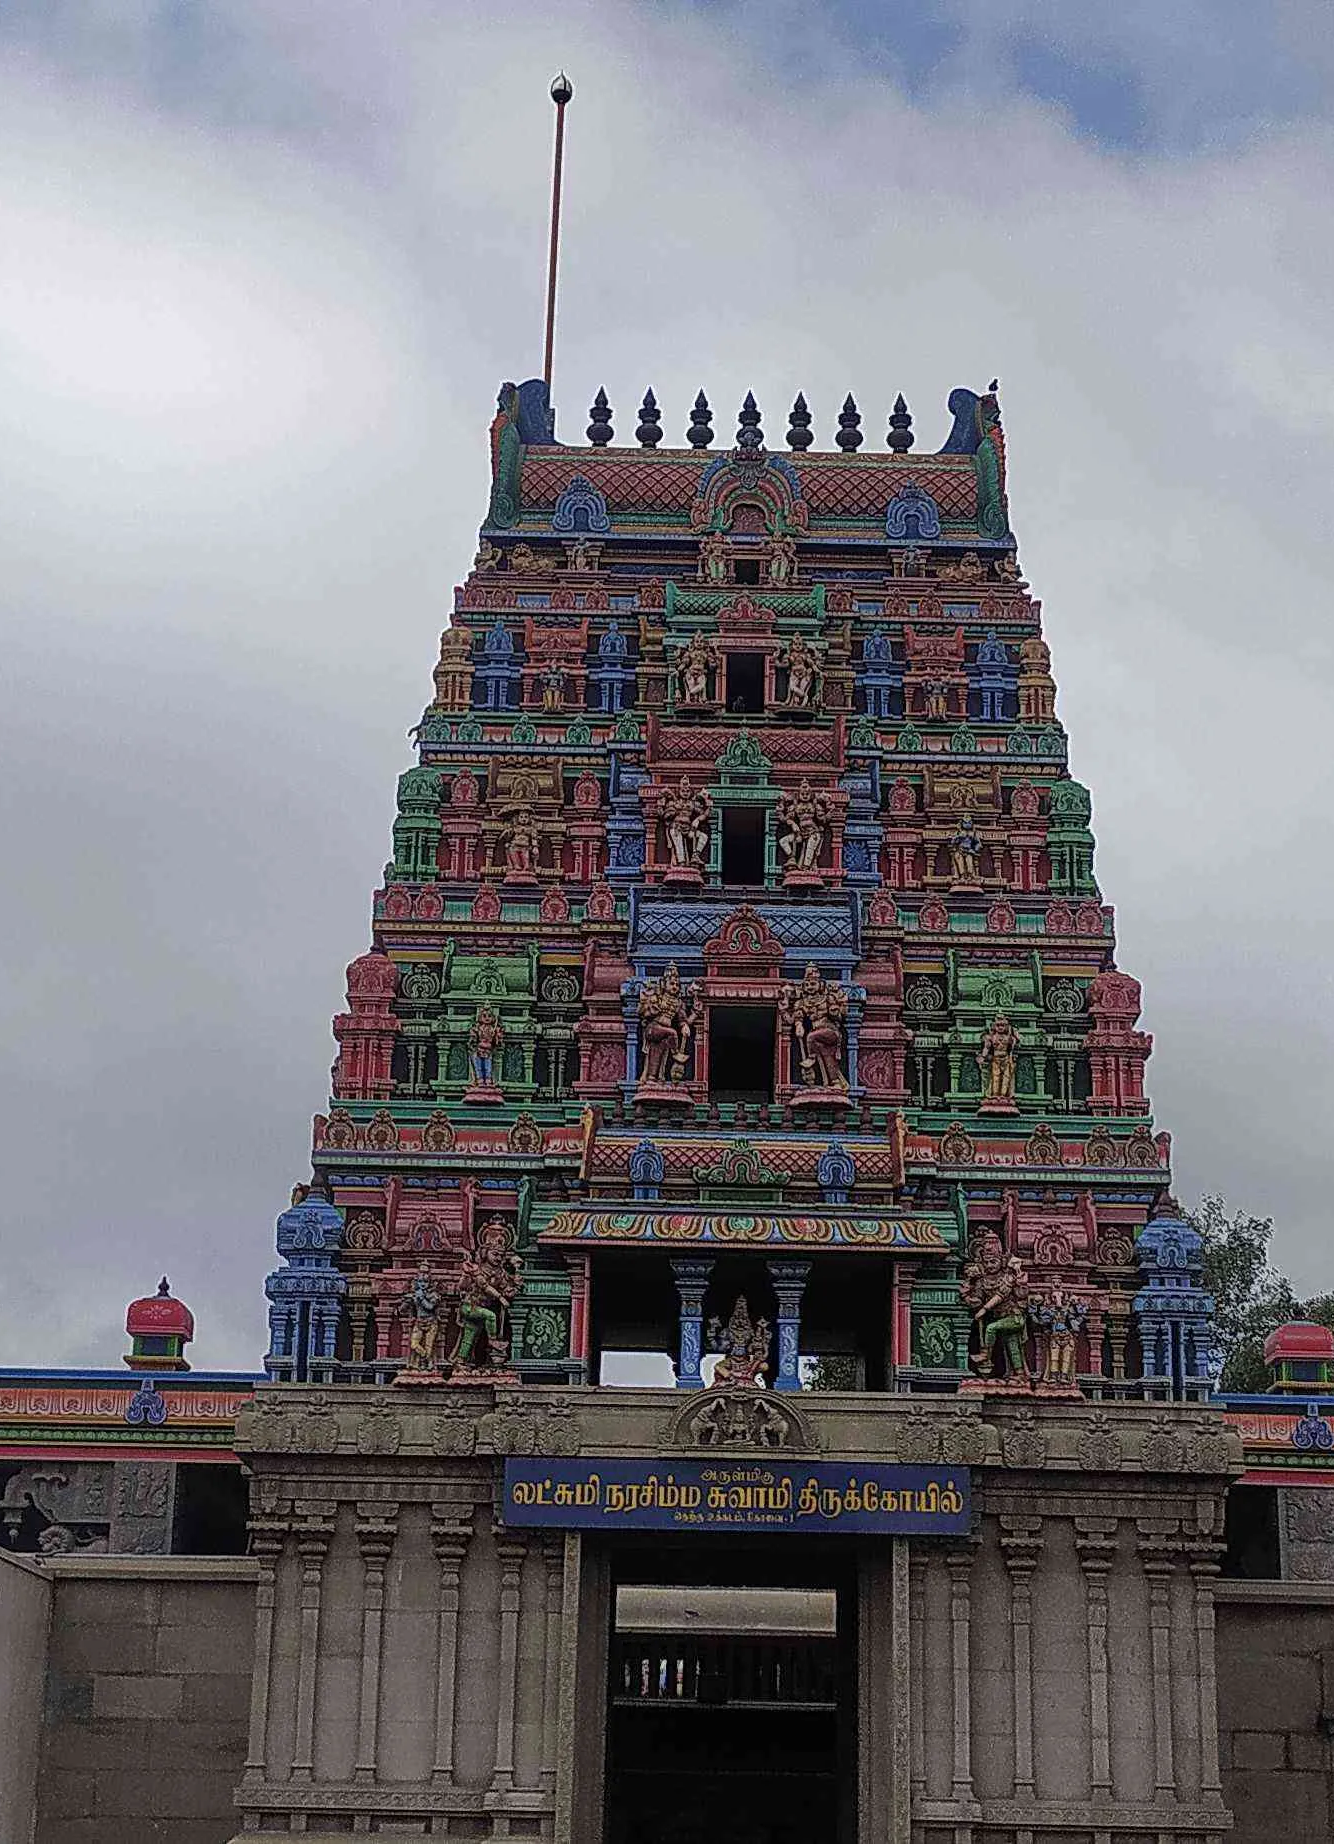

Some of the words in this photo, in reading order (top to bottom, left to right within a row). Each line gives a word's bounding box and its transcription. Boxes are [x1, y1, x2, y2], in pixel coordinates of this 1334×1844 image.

[700, 1468, 775, 1485] அருள்மிகு
[513, 1474, 600, 1505] லட்சுமி
[604, 1475, 701, 1514] நரசிம்ம
[708, 1477, 792, 1510] சுவாமி
[797, 1478, 964, 1519] திருக்கோயில்
